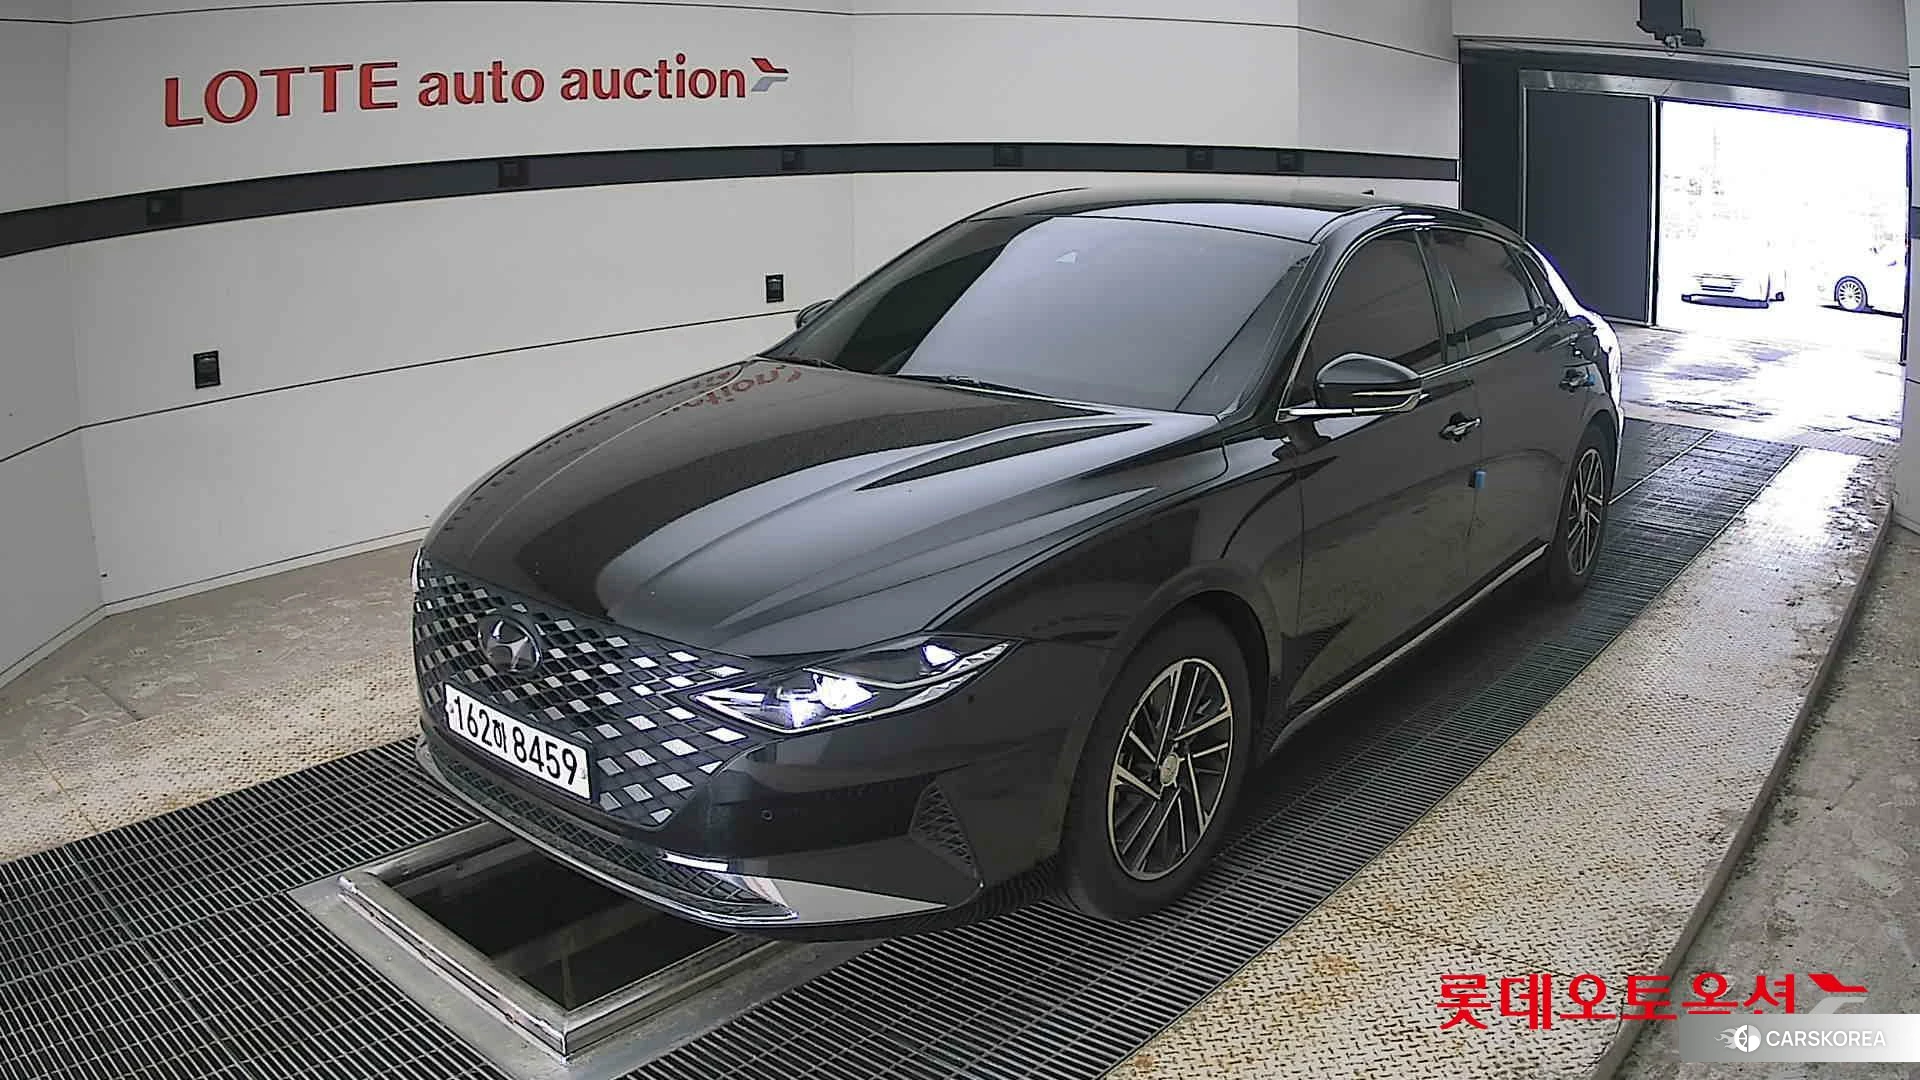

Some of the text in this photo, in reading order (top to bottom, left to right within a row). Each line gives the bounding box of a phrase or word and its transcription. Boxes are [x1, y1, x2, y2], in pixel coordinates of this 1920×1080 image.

[162, 53, 747, 128] LOTTE auto auction
